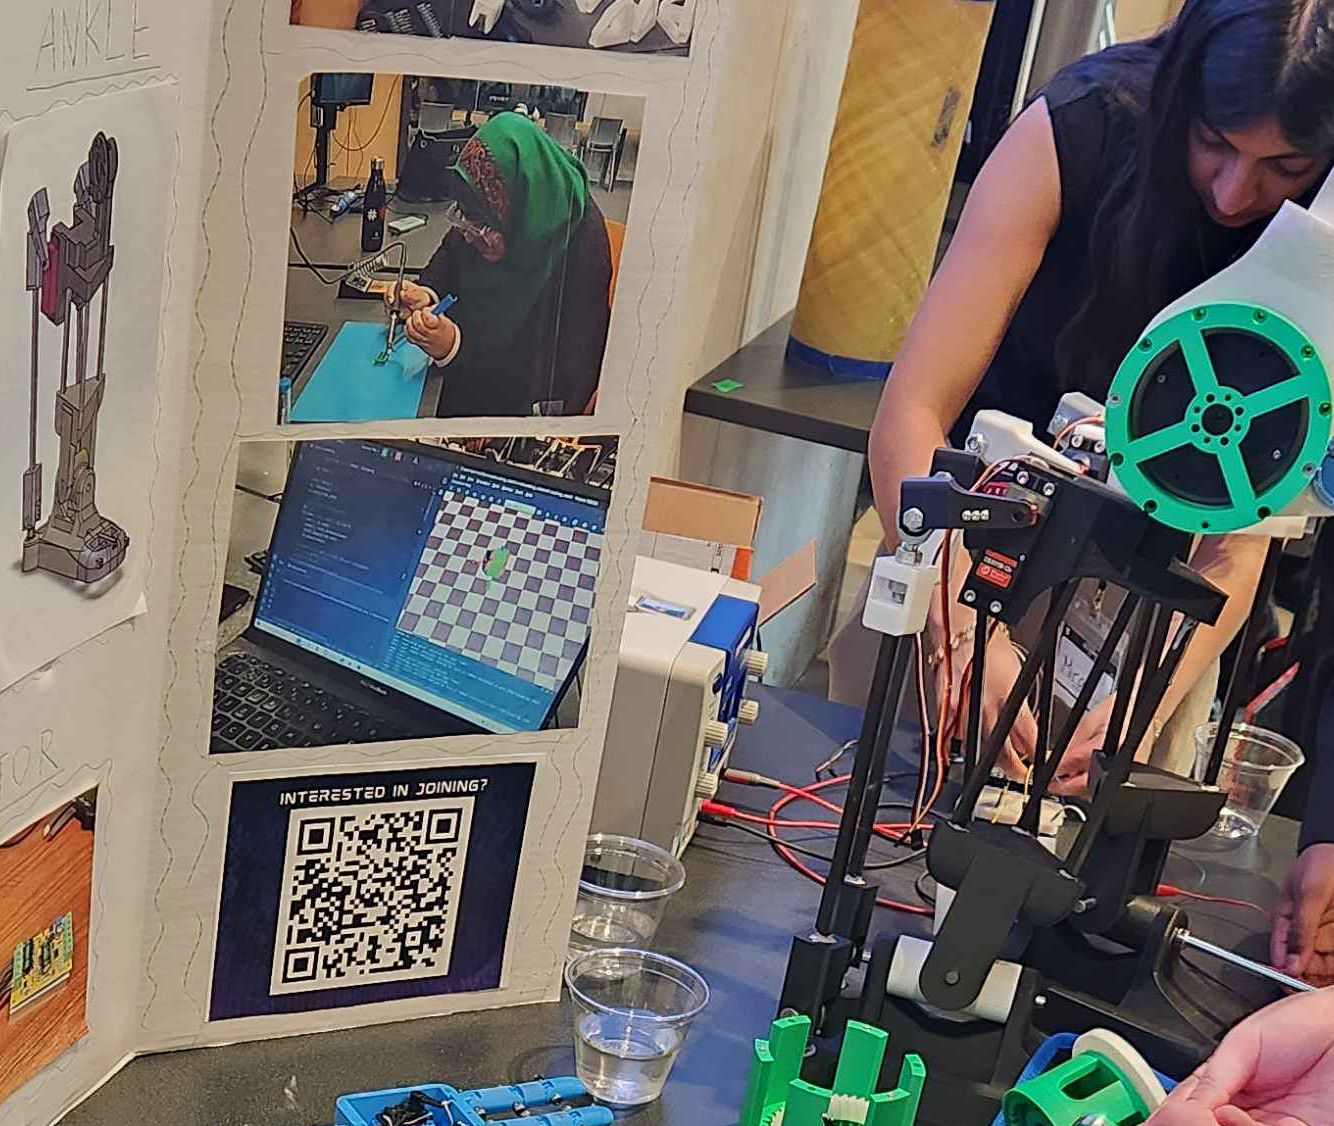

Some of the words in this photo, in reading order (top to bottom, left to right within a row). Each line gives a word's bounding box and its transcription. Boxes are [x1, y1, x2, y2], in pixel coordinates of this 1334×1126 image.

[35, 0, 151, 73] ANKLE
[279, 785, 386, 806] INTERESTED
[392, 782, 410, 798] IN
[415, 779, 488, 796] JOINING?
